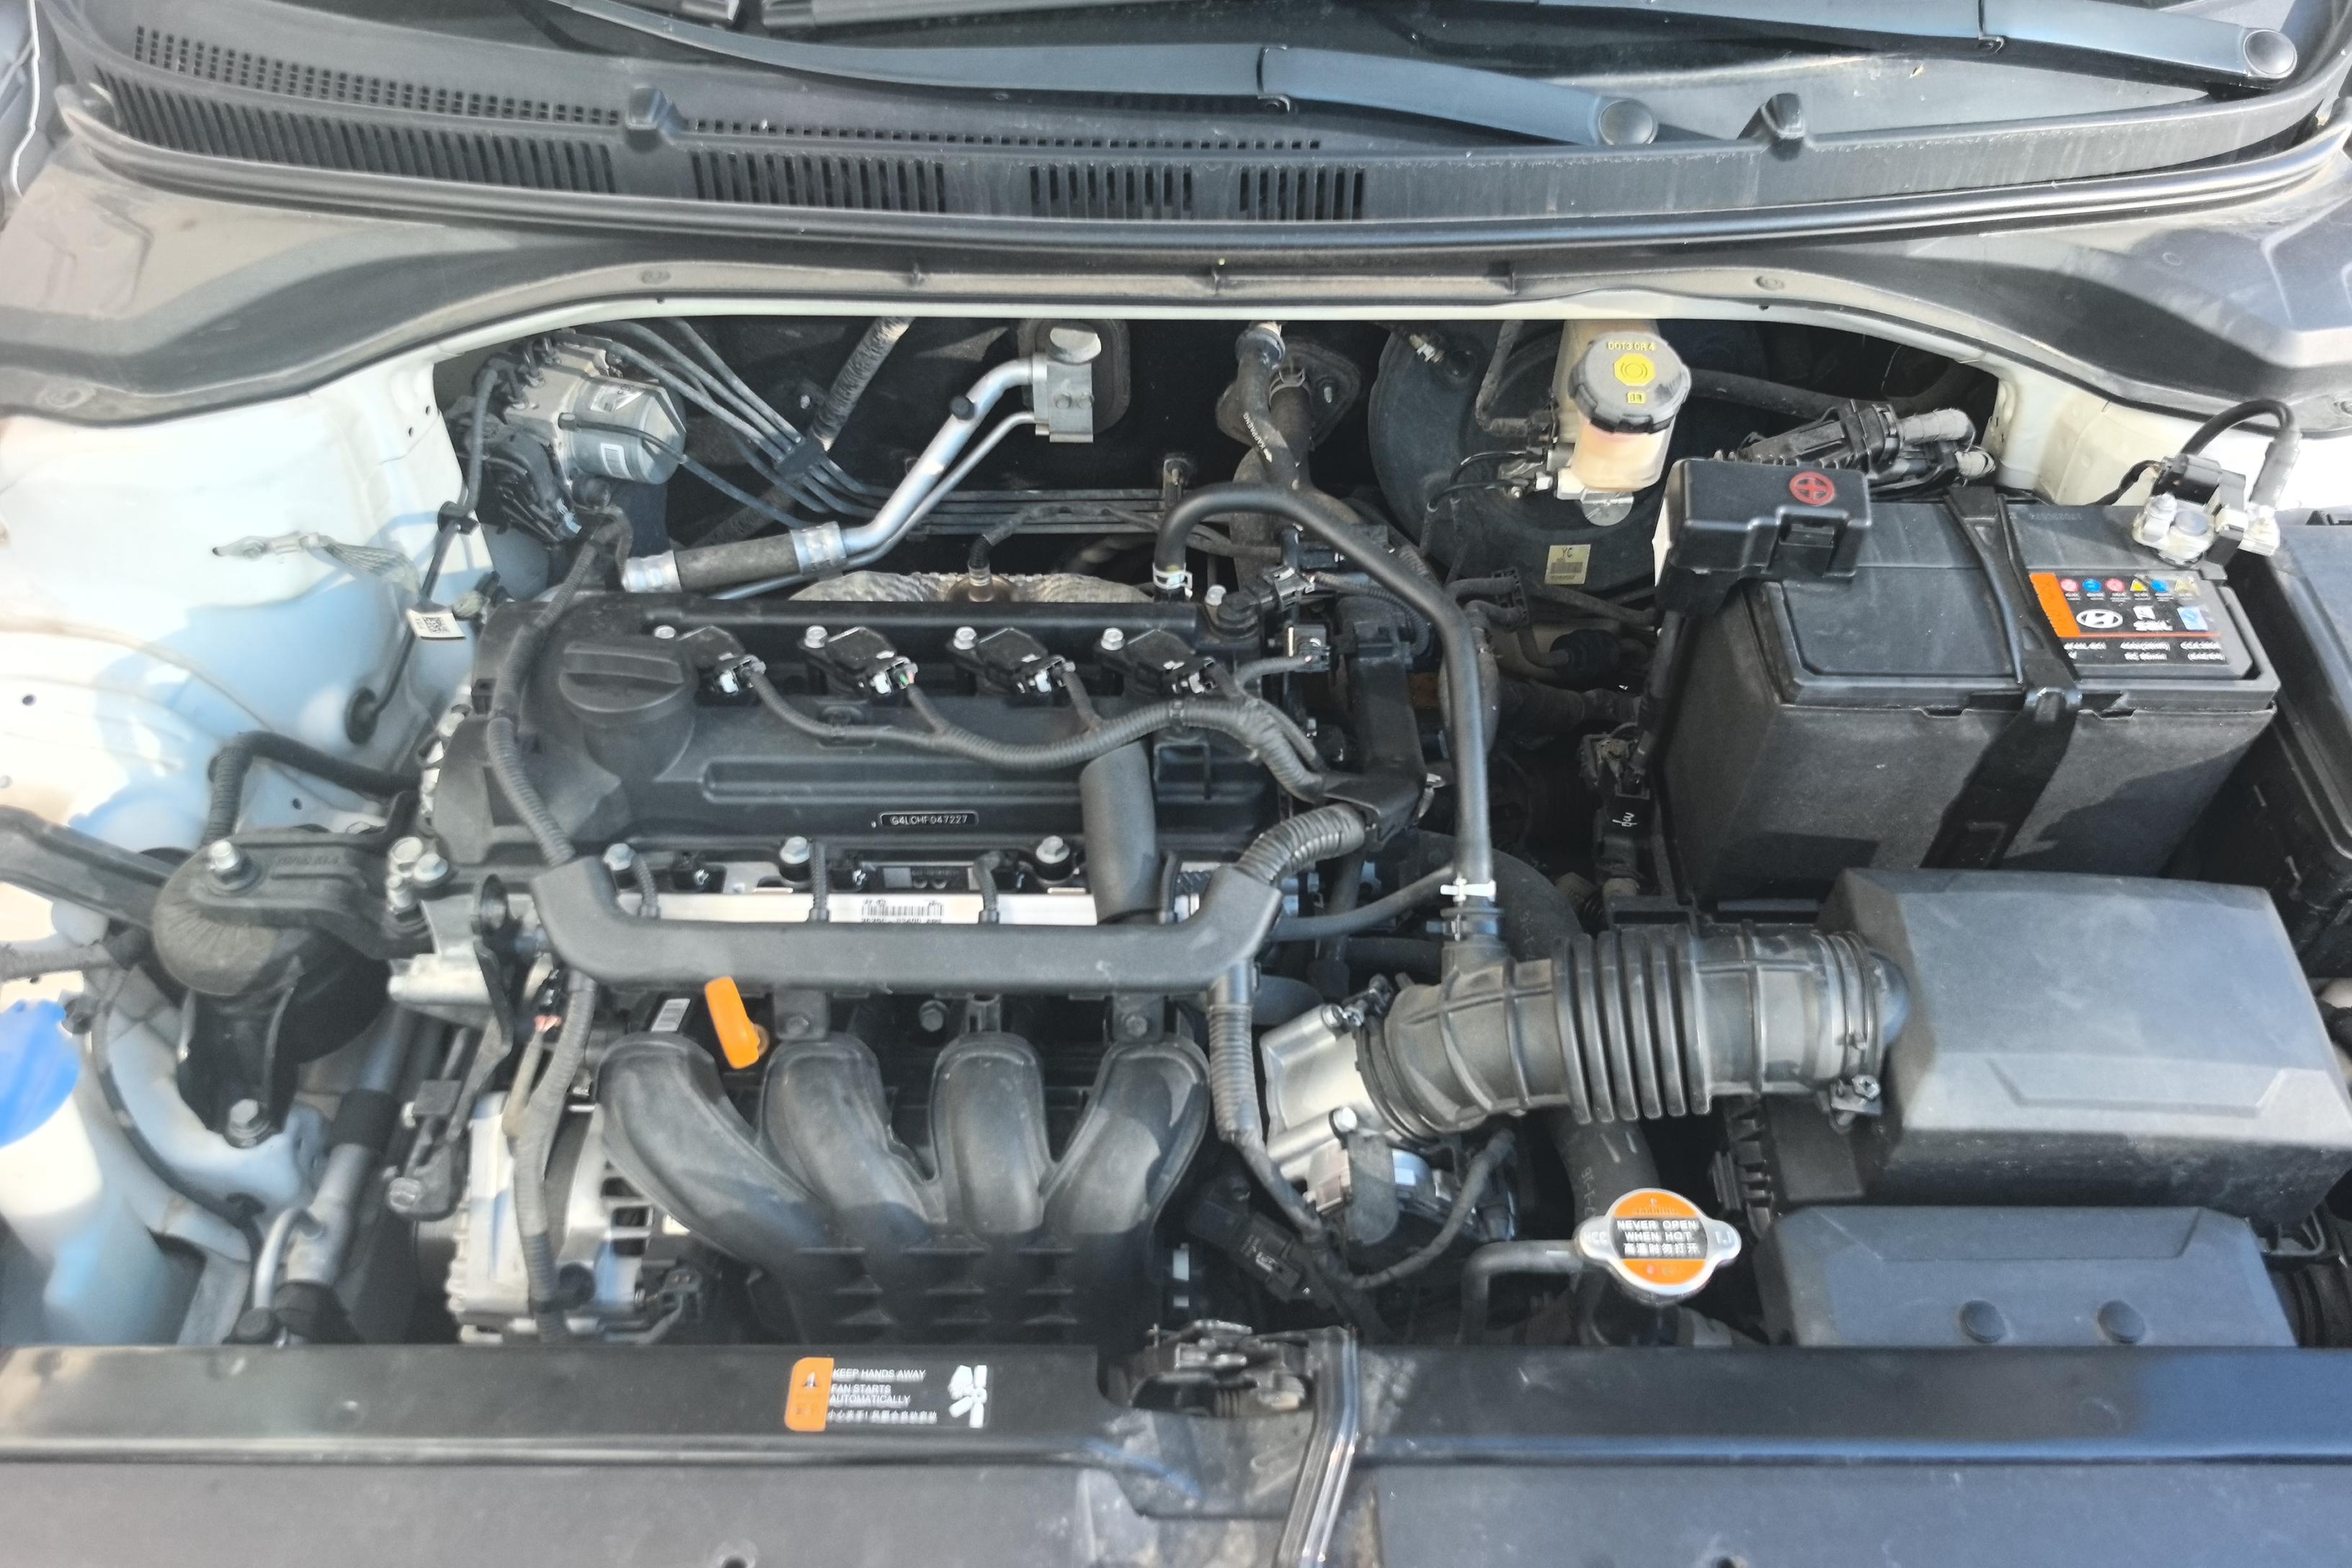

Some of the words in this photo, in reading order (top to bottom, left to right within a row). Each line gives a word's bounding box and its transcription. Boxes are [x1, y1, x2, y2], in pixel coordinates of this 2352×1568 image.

[1608, 342, 1631, 351] DOT3
[1634, 342, 1647, 351] OR
[1648, 342, 1655, 351] 4
[1617, 1220, 1657, 1231] NEVER
[1662, 1220, 1697, 1231] OPEN
[1625, 1231, 1660, 1242] WHEN
[832, 1368, 859, 1381] KEEP
[861, 1369, 894, 1381] HANDS
[896, 1369, 926, 1381] AWAY
[831, 1384, 850, 1394] FAN
[852, 1384, 891, 1394] STARTS
[829, 1395, 911, 1407] AUTOMATICALLY
